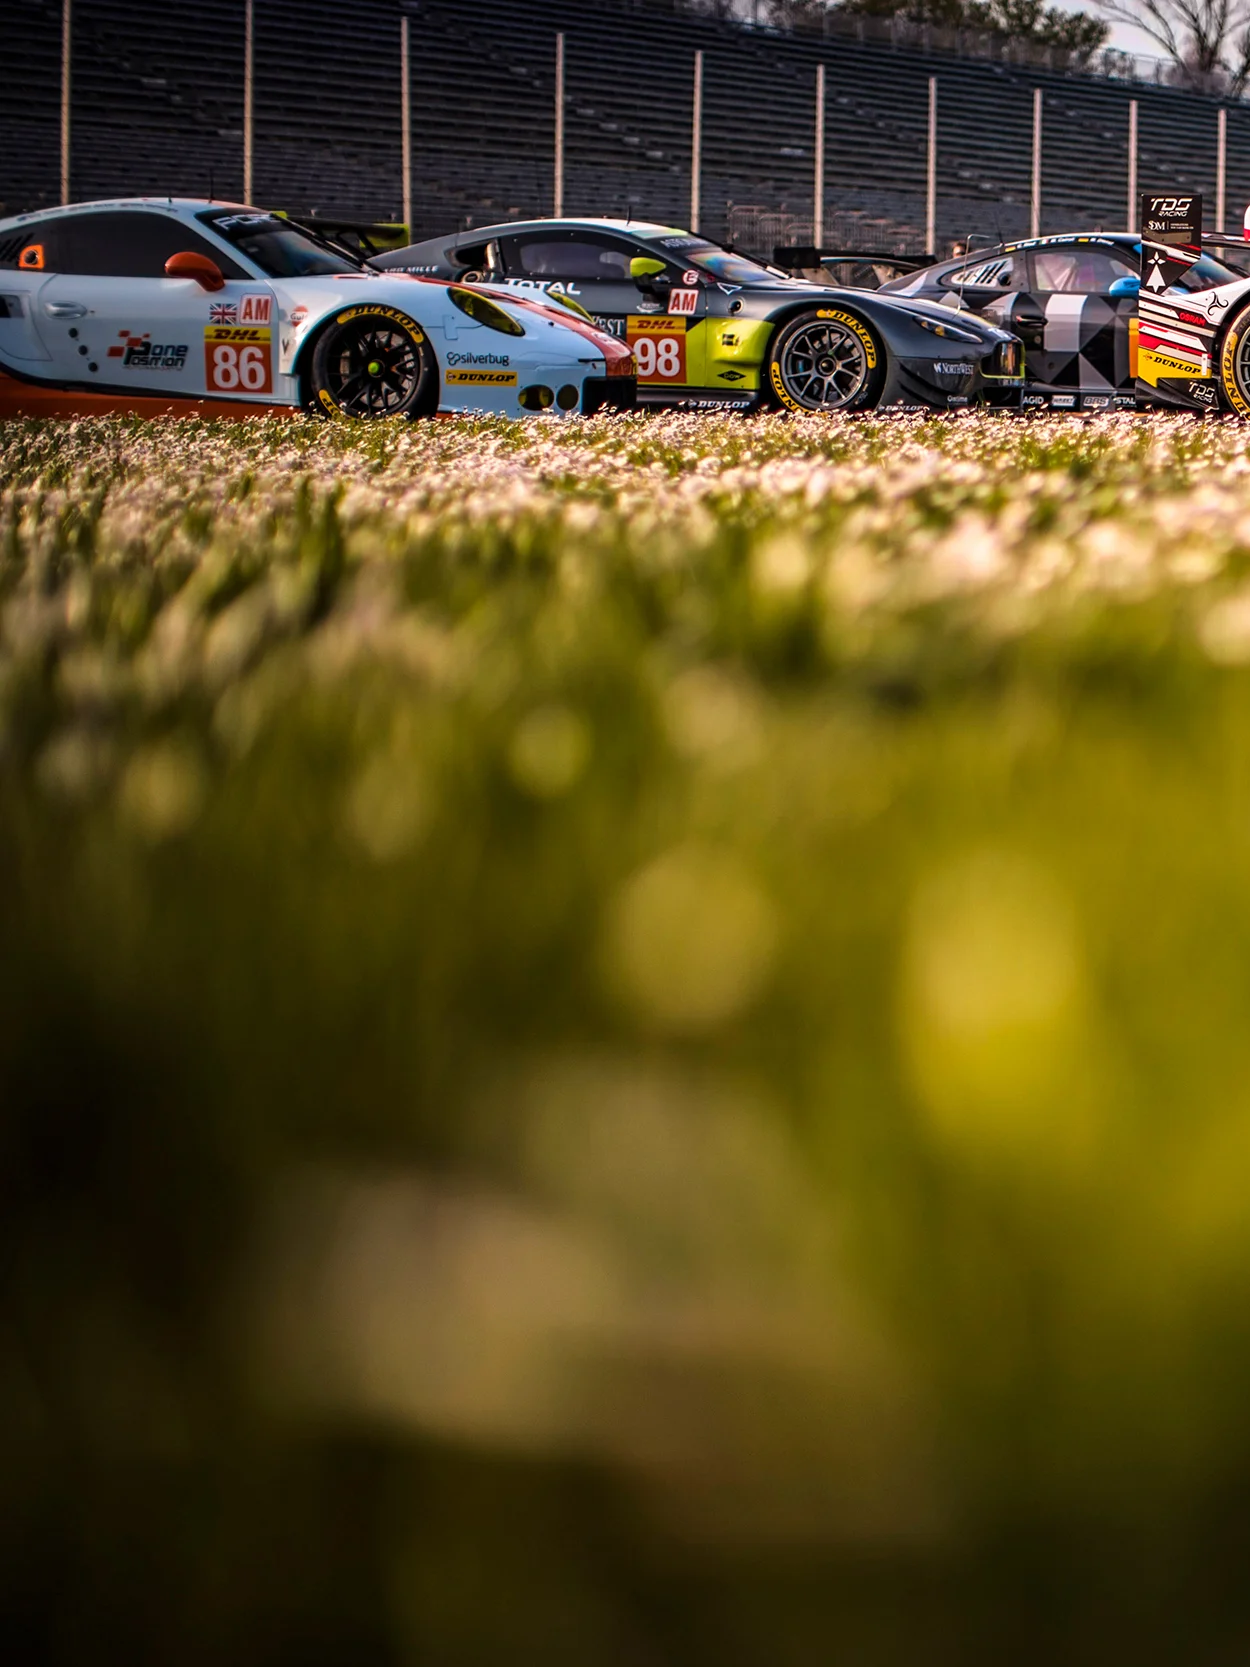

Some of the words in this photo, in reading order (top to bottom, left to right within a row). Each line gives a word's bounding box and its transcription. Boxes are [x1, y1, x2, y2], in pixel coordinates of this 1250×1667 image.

[1150, 198, 1192, 211] TDS
[504, 277, 582, 295] TOTAL
[242, 298, 270, 321] AM
[672, 293, 696, 311] AM
[354, 305, 420, 336] DUNLOP
[637, 320, 676, 329] DHL
[1179, 312, 1206, 327] OSRAM
[213, 329, 261, 341] DHL
[832, 312, 875, 362] DUNLOP
[460, 352, 511, 367] silverbug
[633, 338, 681, 377] 98
[1153, 356, 1202, 375] DUNLOP
[213, 345, 266, 390] 86
[457, 373, 516, 382] DUNLOP
[1188, 381, 1216, 398] TDS
[697, 400, 751, 409] DUNLOP
[1022, 396, 1045, 405] AGID
